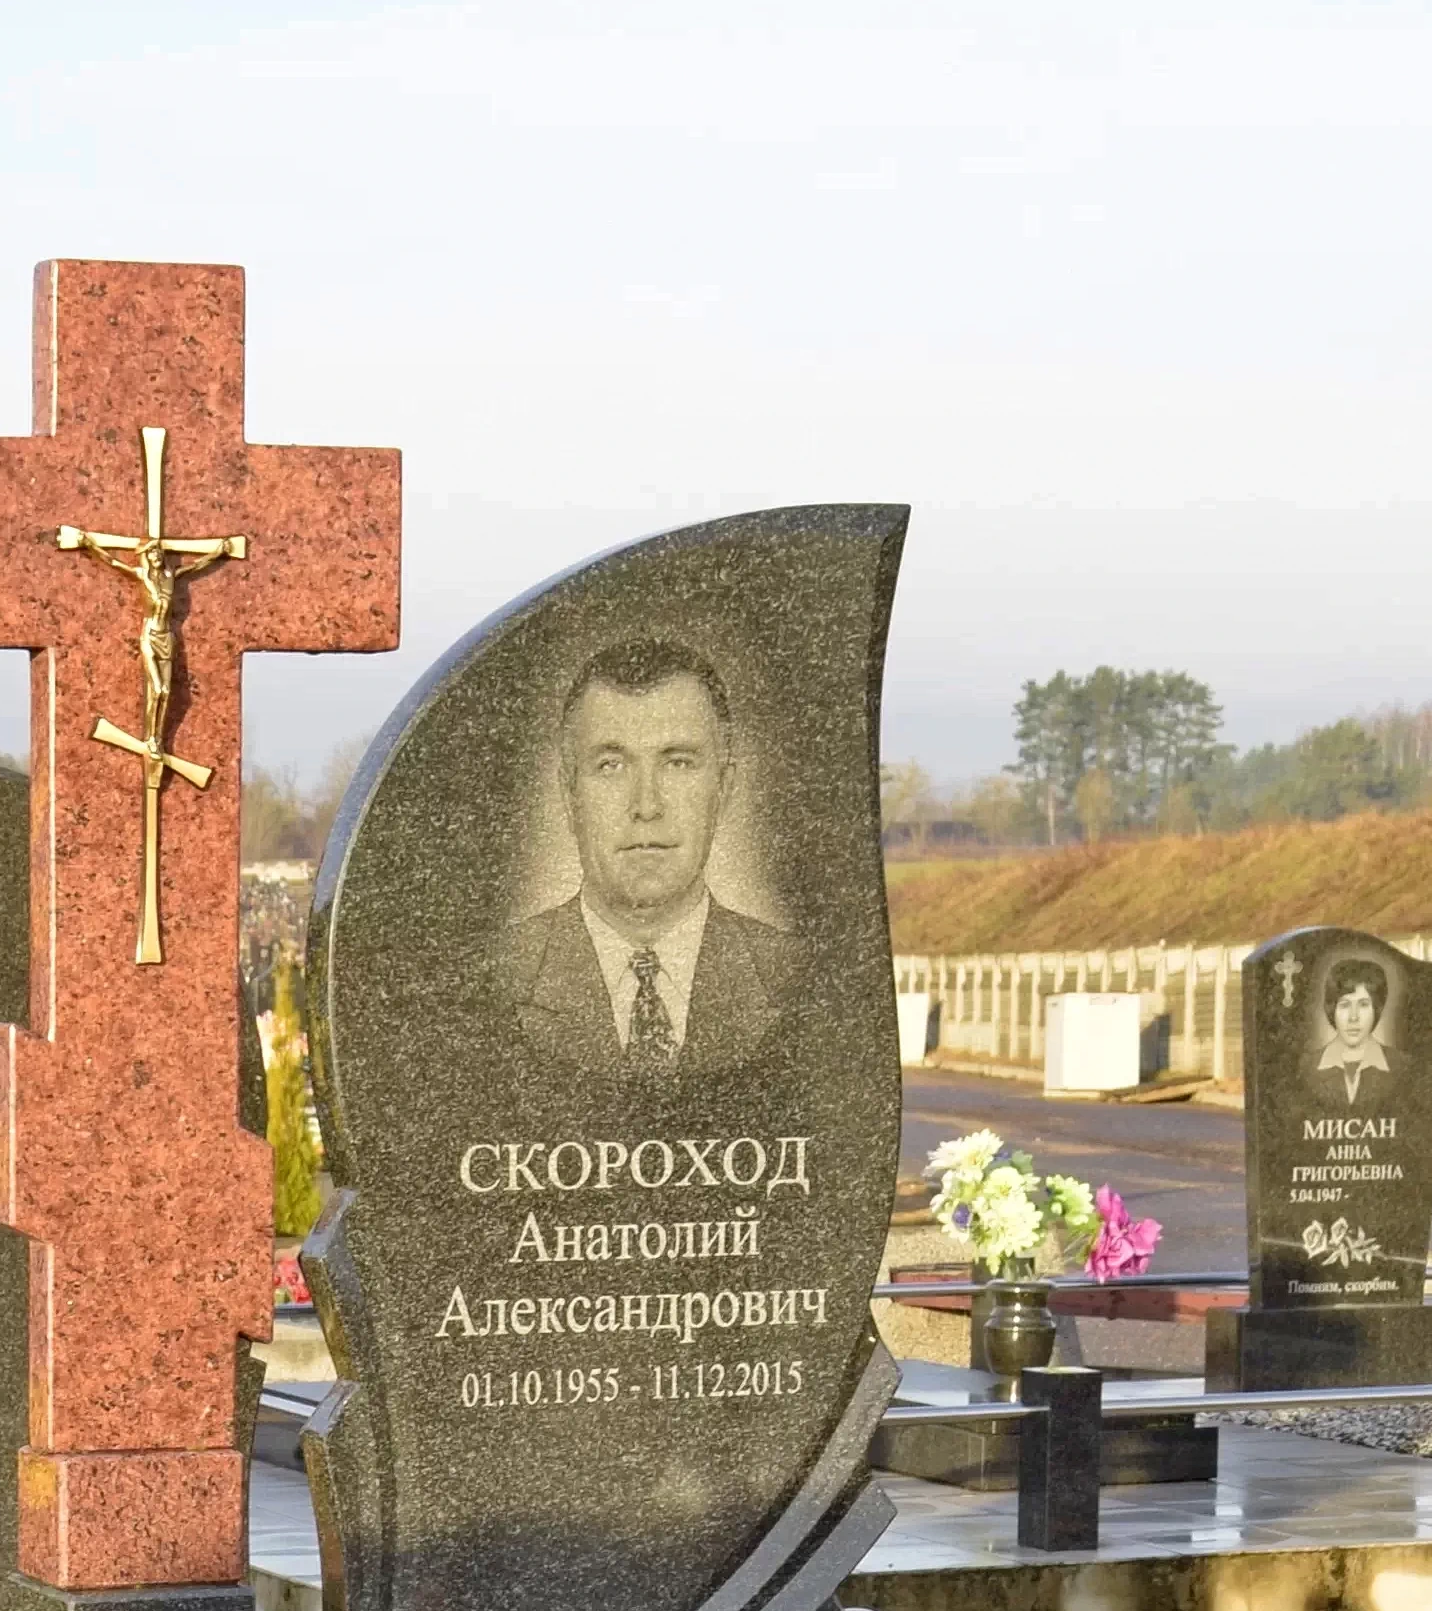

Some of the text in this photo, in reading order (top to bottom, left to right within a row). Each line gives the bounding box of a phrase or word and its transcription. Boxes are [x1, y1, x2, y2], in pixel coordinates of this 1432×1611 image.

[1302, 1118, 1397, 1140] МИСАН
[1326, 1145, 1372, 1160] АННА
[460, 1136, 812, 1195] СКОРОХОД
[1291, 1164, 1404, 1182] ГРИГОРЬЕВНА
[508, 1205, 761, 1263] Анатолий
[435, 1285, 829, 1343] Александрович
[462, 1367, 619, 1410] 01.10.1955
[651, 1361, 803, 1400] 11.12.2015
